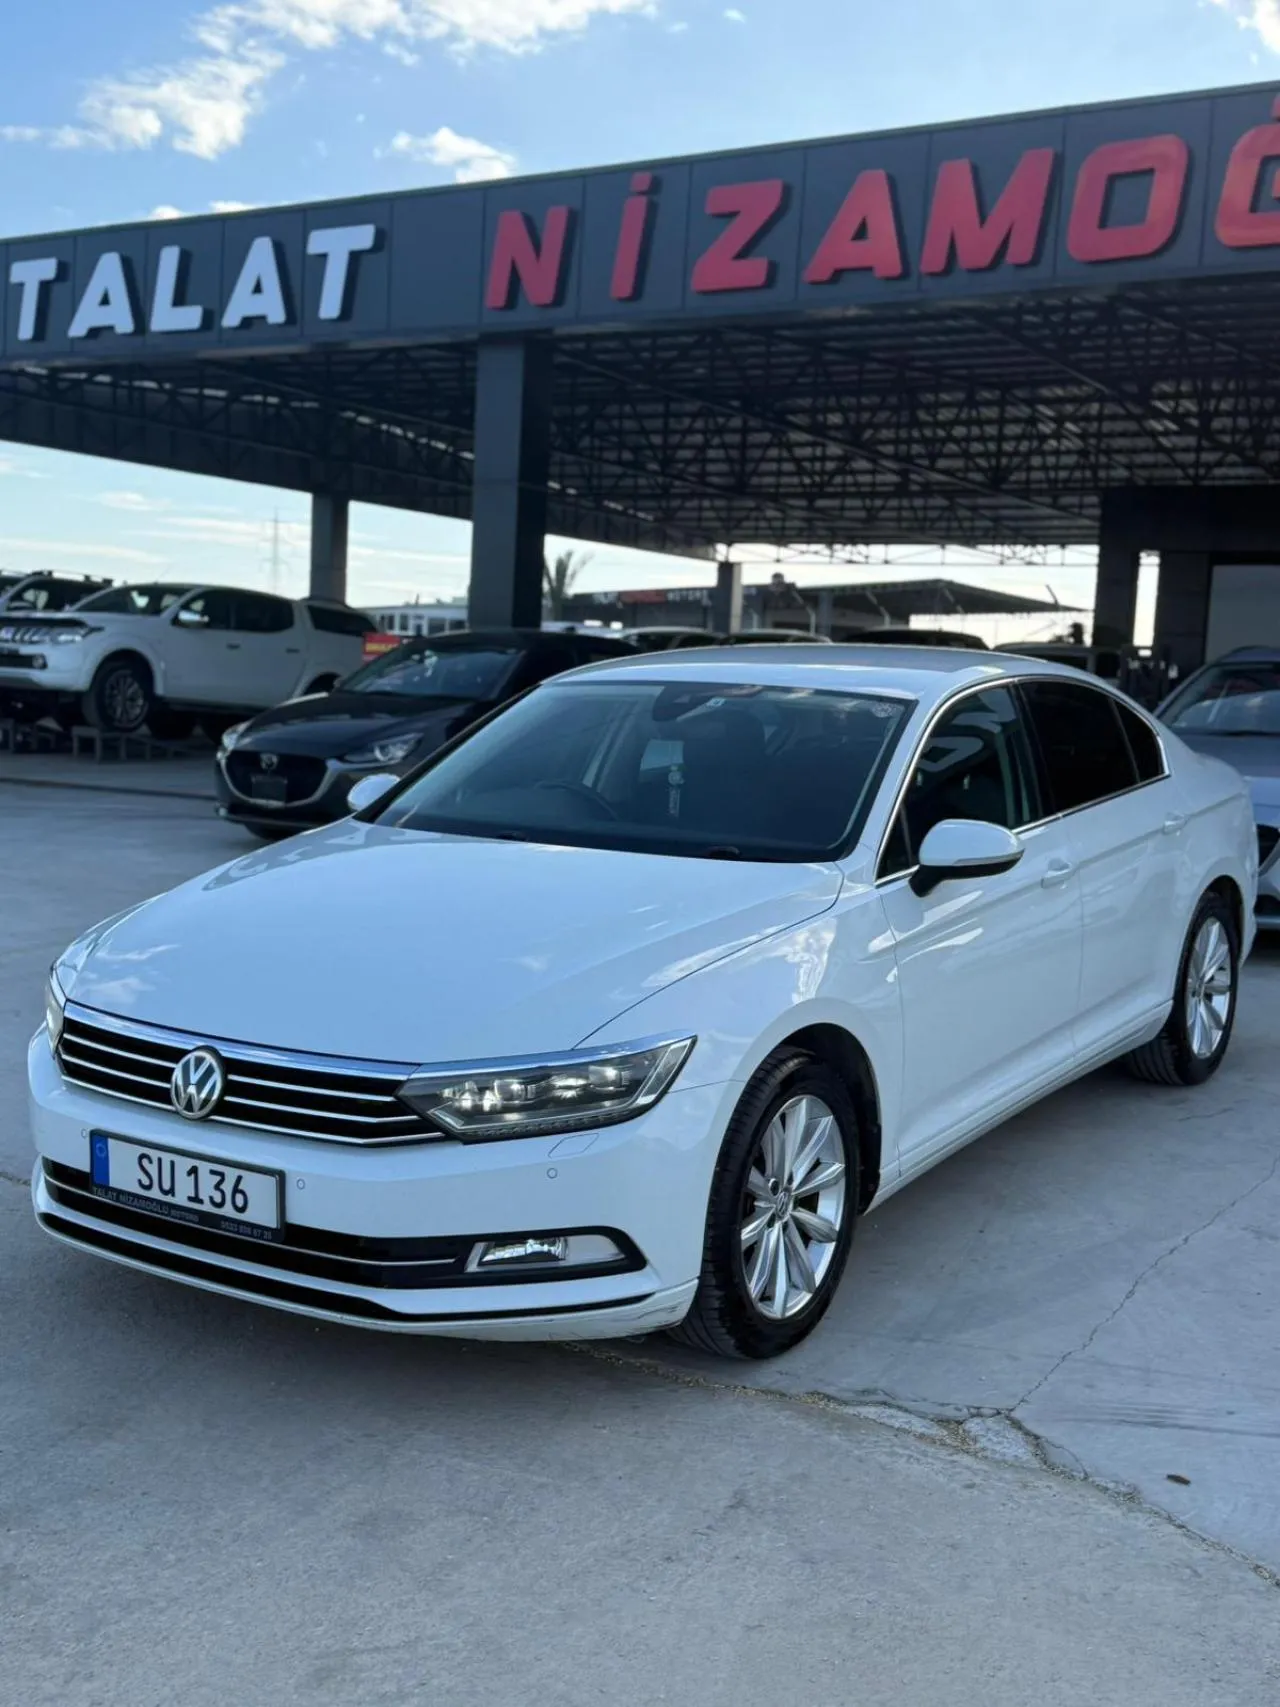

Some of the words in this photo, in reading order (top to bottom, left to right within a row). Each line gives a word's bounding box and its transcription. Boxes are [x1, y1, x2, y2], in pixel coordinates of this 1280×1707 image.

[9, 223, 376, 342] TALAT
[137, 1153, 176, 1197] SU
[186, 1165, 249, 1214] 136
